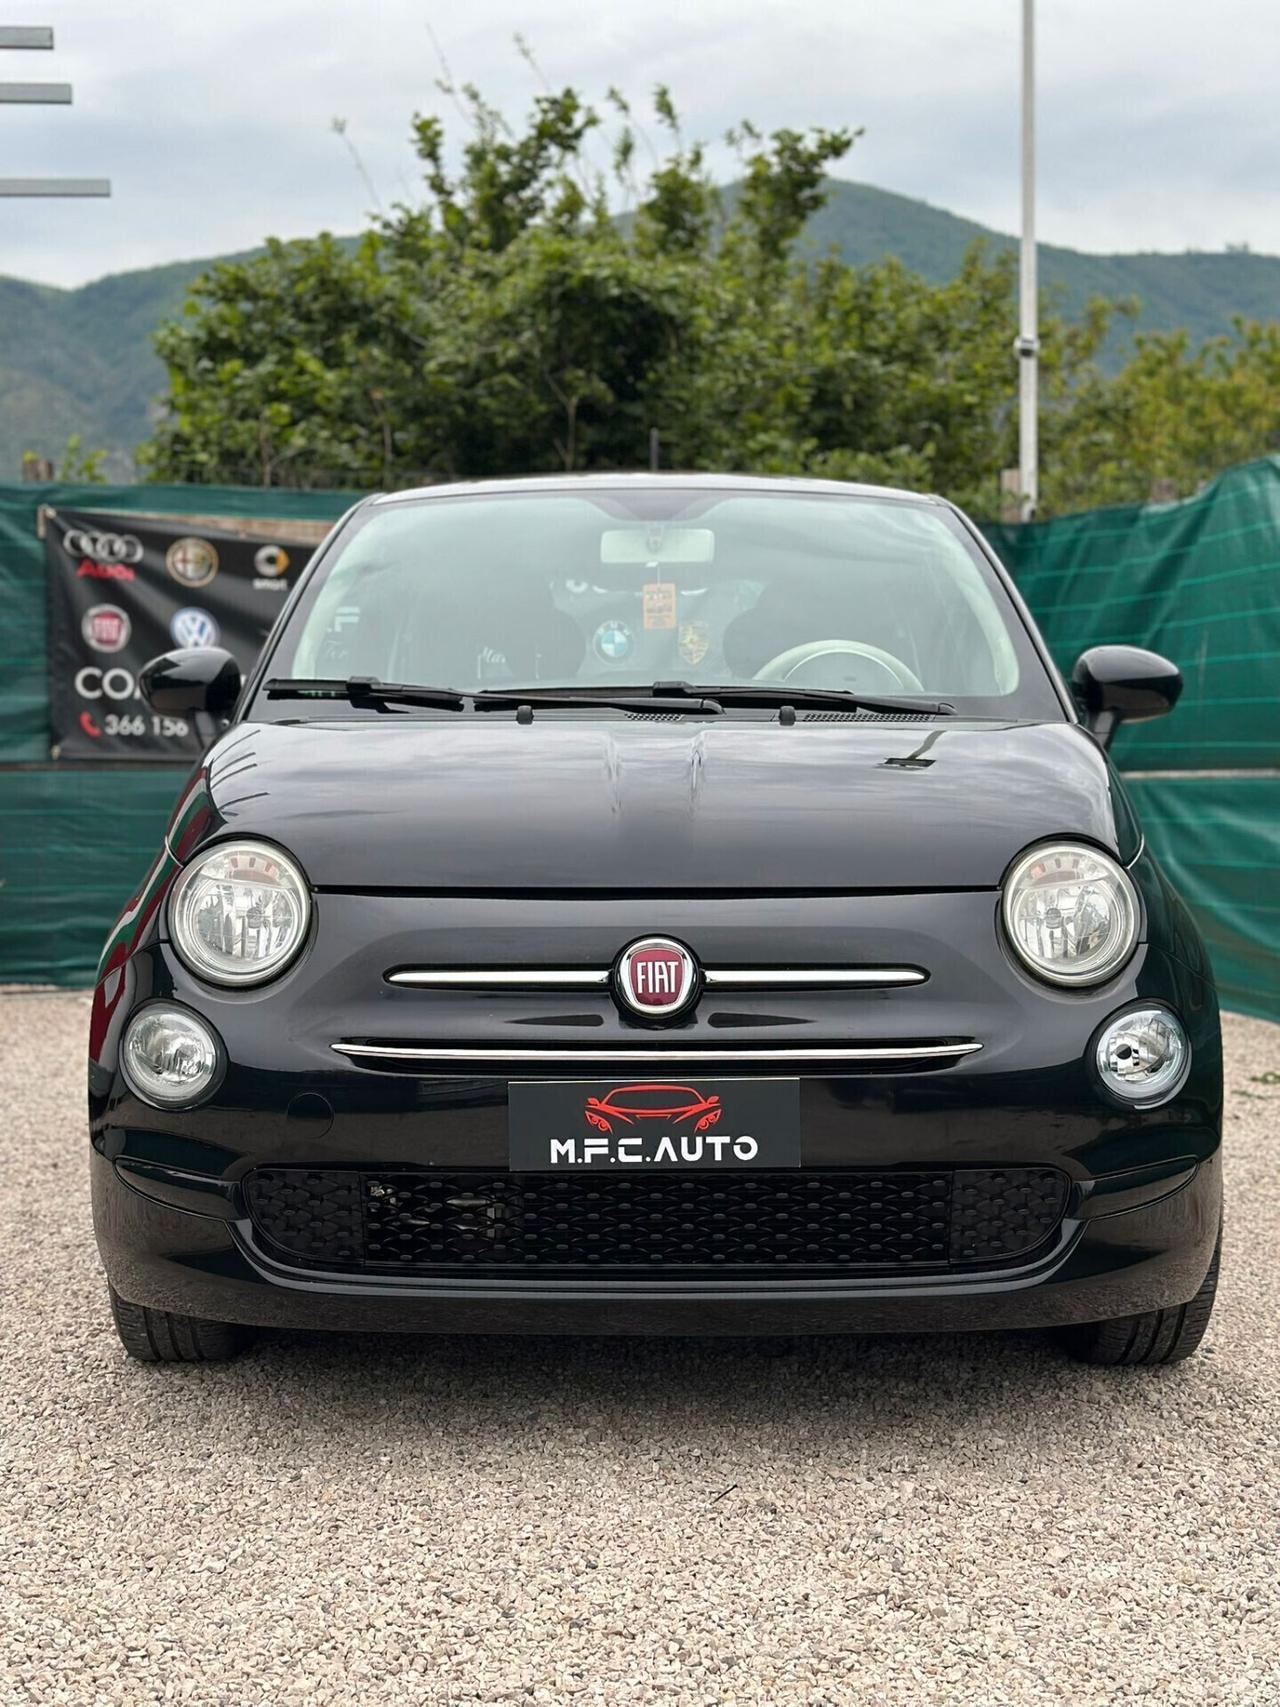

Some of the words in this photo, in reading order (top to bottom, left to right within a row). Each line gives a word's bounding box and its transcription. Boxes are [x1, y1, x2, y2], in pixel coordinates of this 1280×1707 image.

[104, 713, 146, 736] 366
[636, 961, 679, 993] FIAT
[550, 1135, 759, 1164] M.F.C.AUTO
